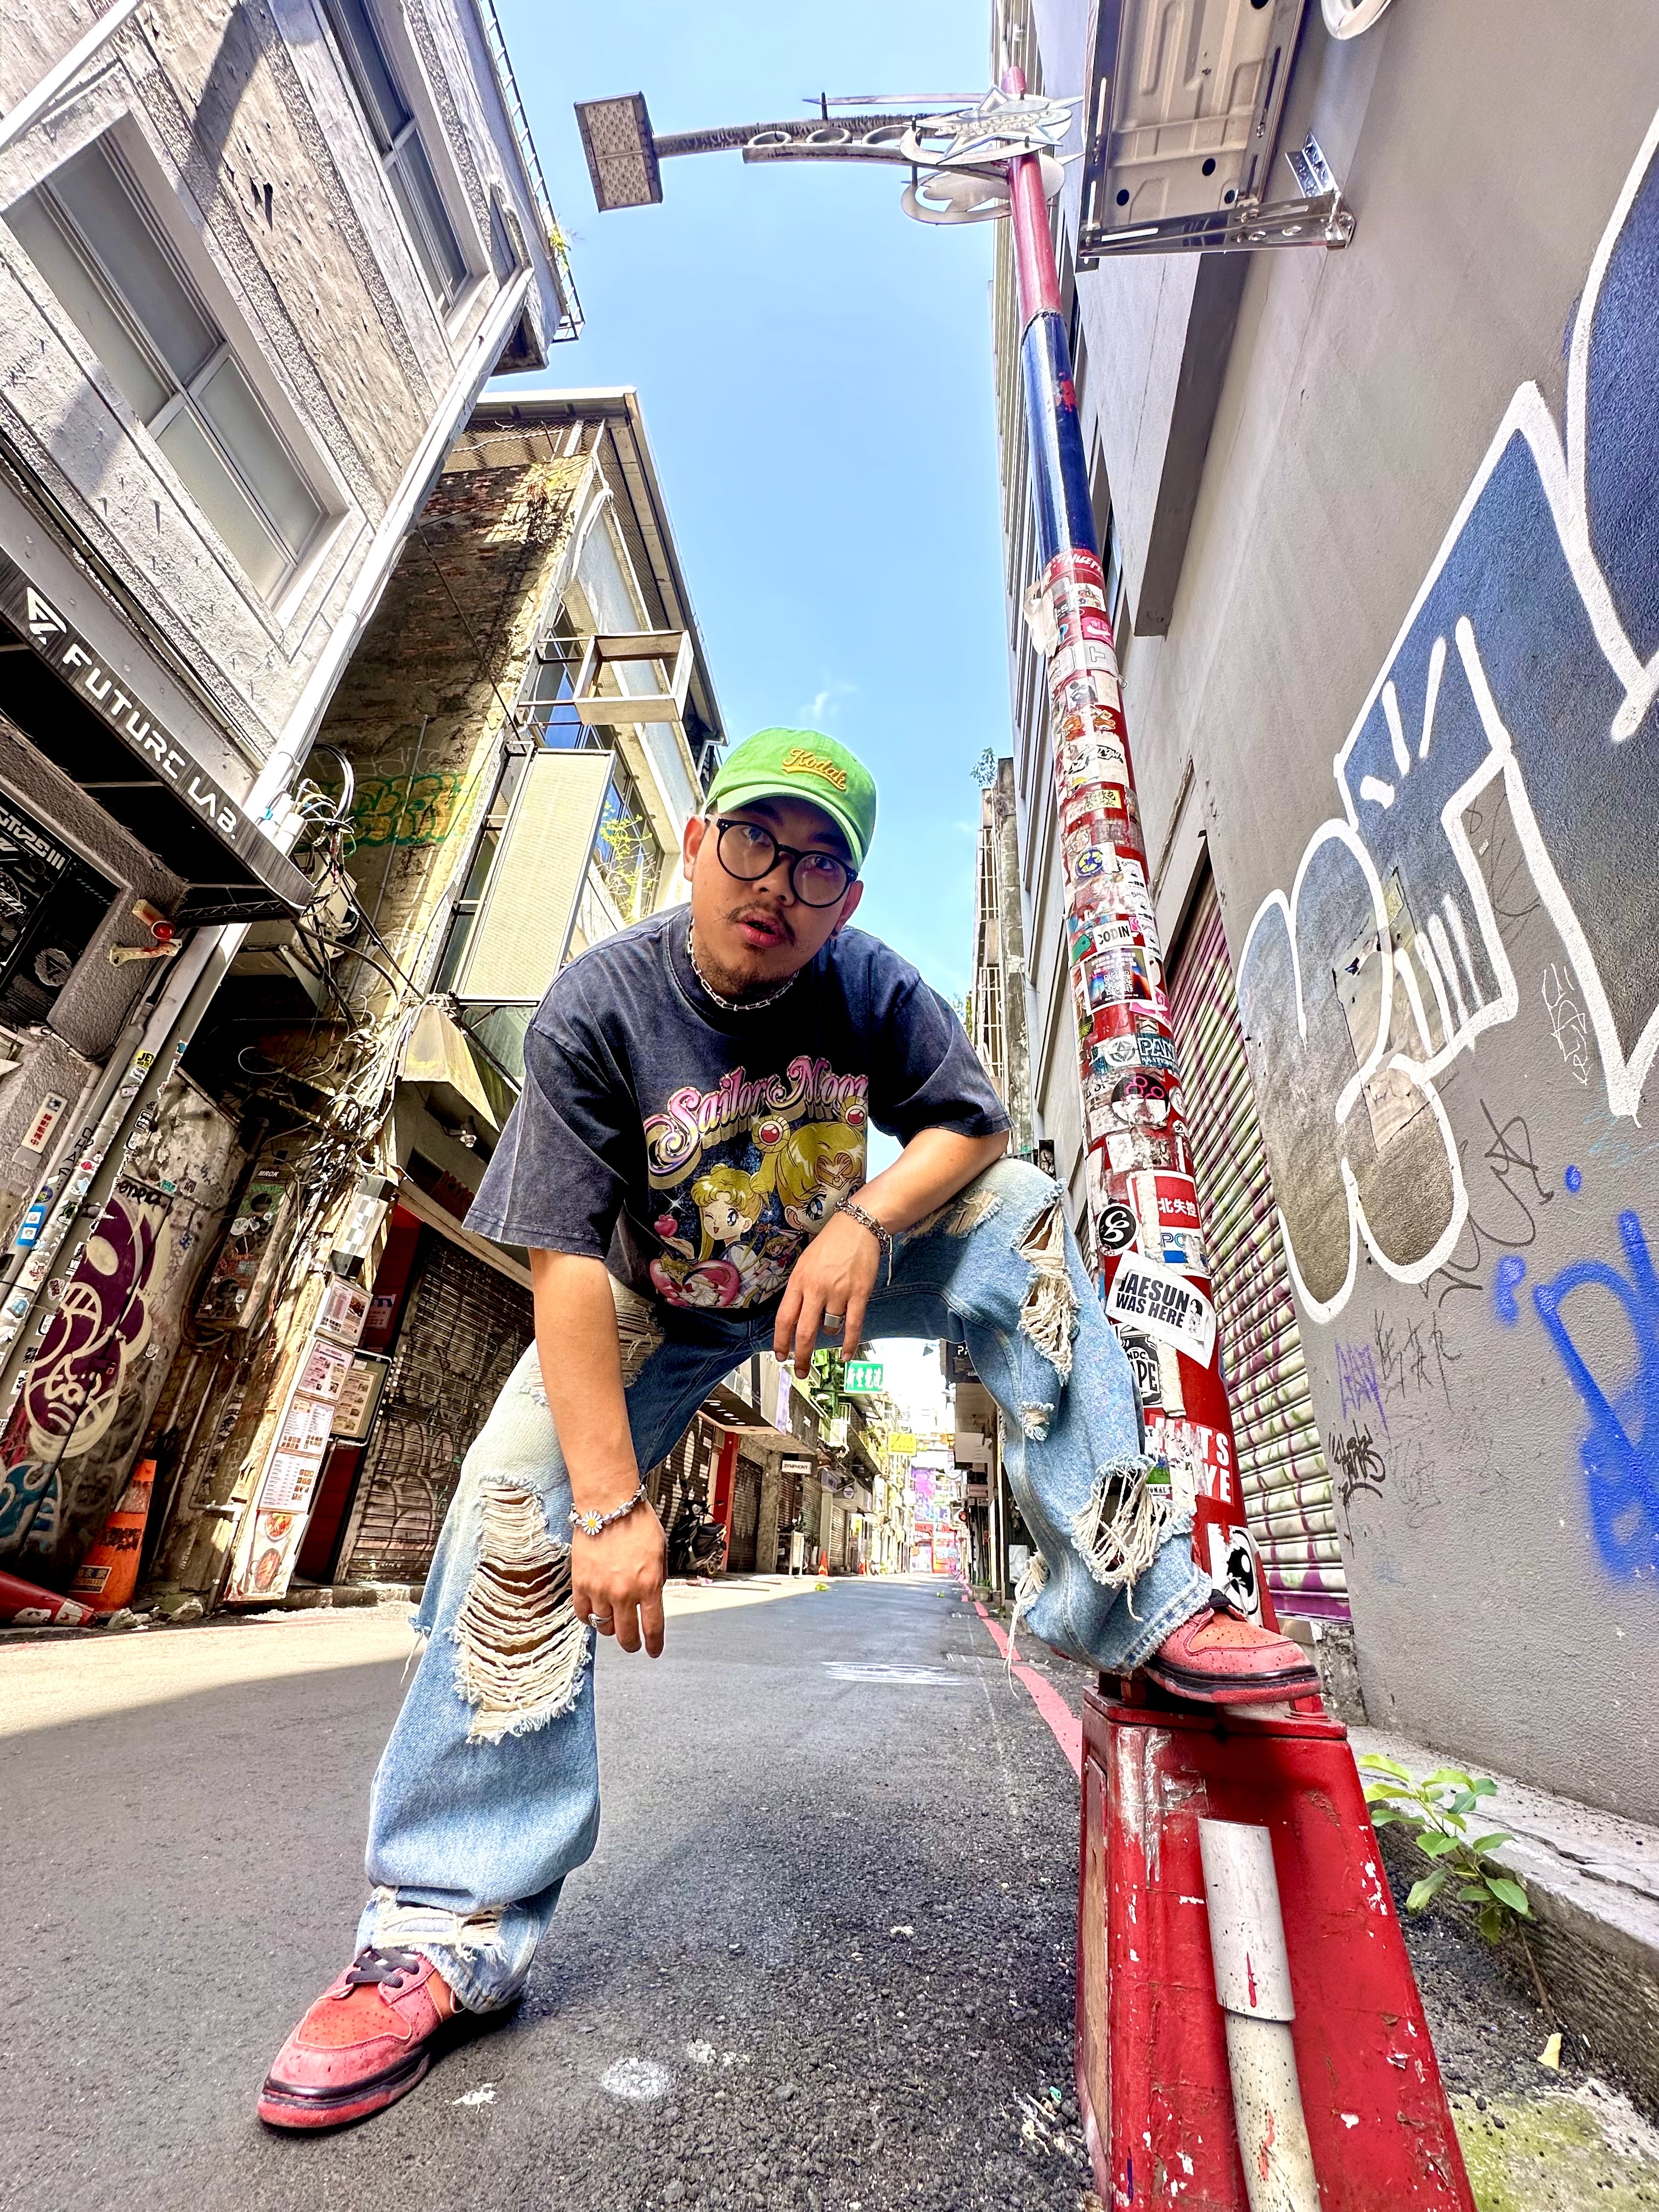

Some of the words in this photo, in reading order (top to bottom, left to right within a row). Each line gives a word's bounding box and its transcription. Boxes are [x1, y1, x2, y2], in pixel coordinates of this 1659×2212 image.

[63, 644, 185, 780] FUTURE
[781, 748, 847, 791] Kodak
[643, 1065, 769, 1189] Sailor
[1158, 1197, 1197, 1217] 北失控
[1116, 1292, 1145, 1314] WAS
[1148, 1301, 1184, 1329] HERE
[1118, 1273, 1189, 1312] JAESUN
[1130, 1359, 1158, 1392] PE
